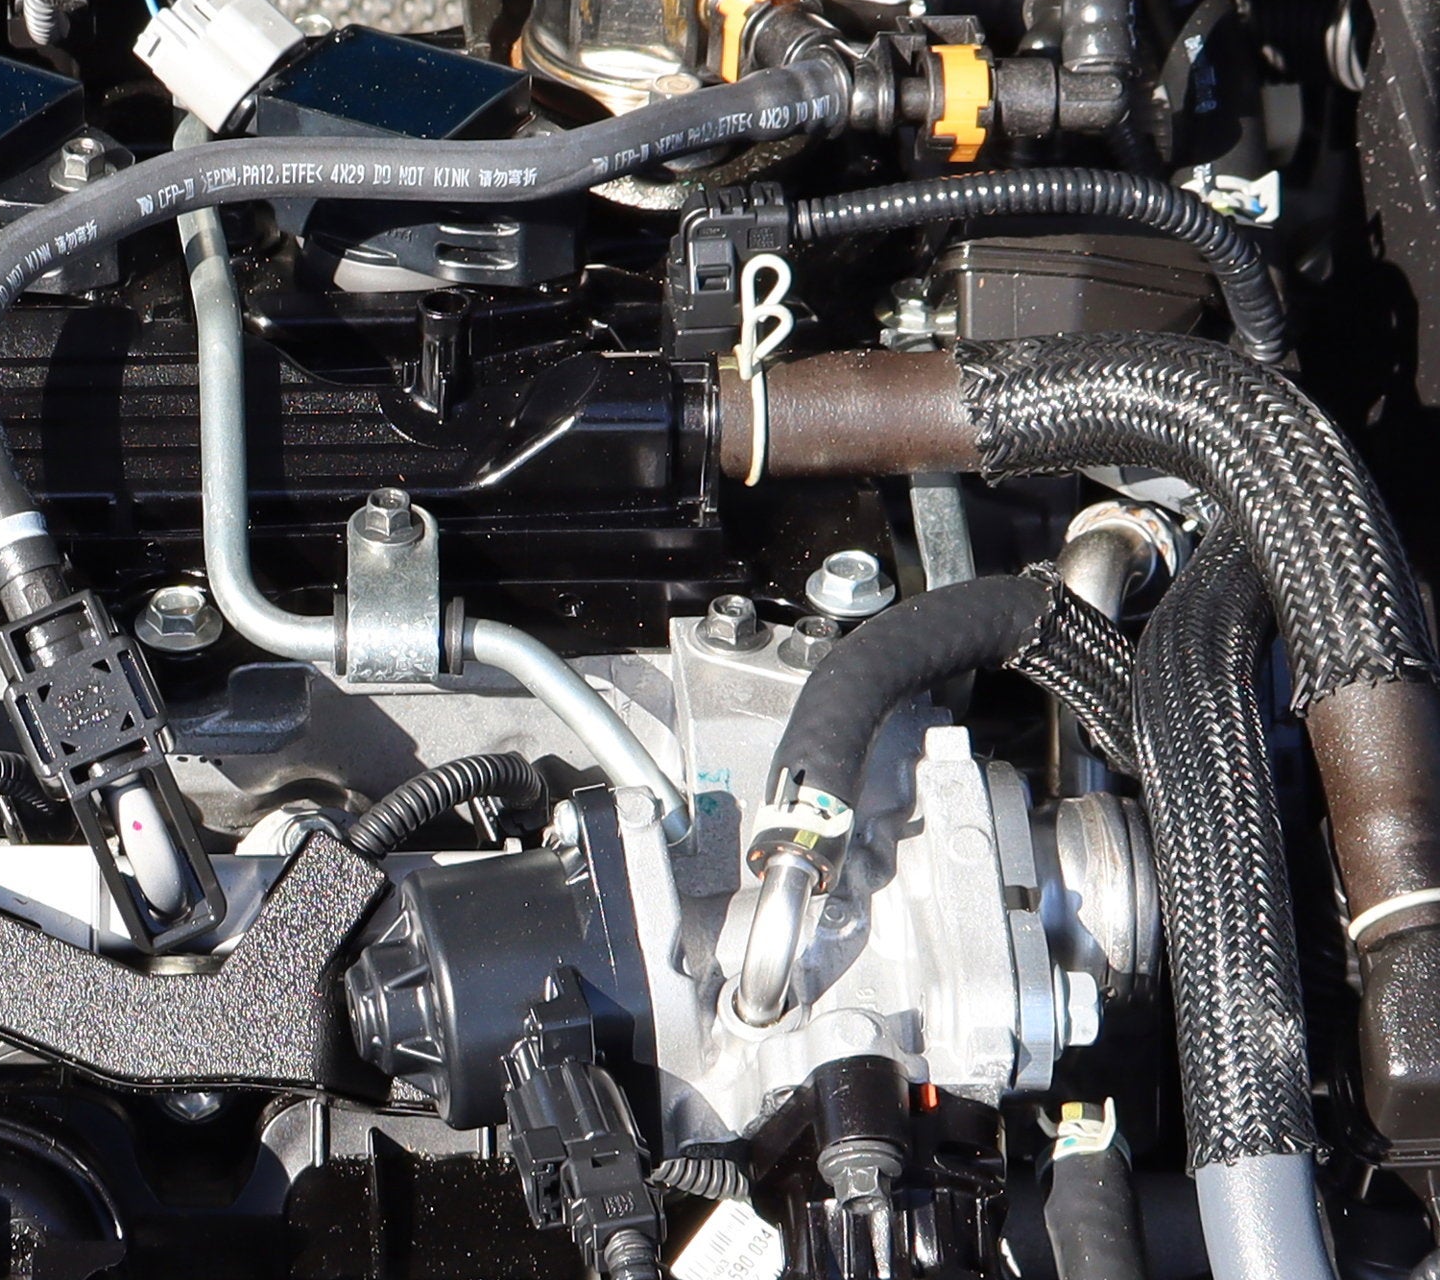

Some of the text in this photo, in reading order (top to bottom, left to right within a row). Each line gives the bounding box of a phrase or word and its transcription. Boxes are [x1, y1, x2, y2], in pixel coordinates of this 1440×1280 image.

[330, 164, 365, 184] 4X29
[399, 166, 424, 187] NOT
[433, 167, 470, 187] KINK
[6, 263, 25, 293] NOT
[24, 242, 53, 274] KINK
[748, 1227, 774, 1256] 034
